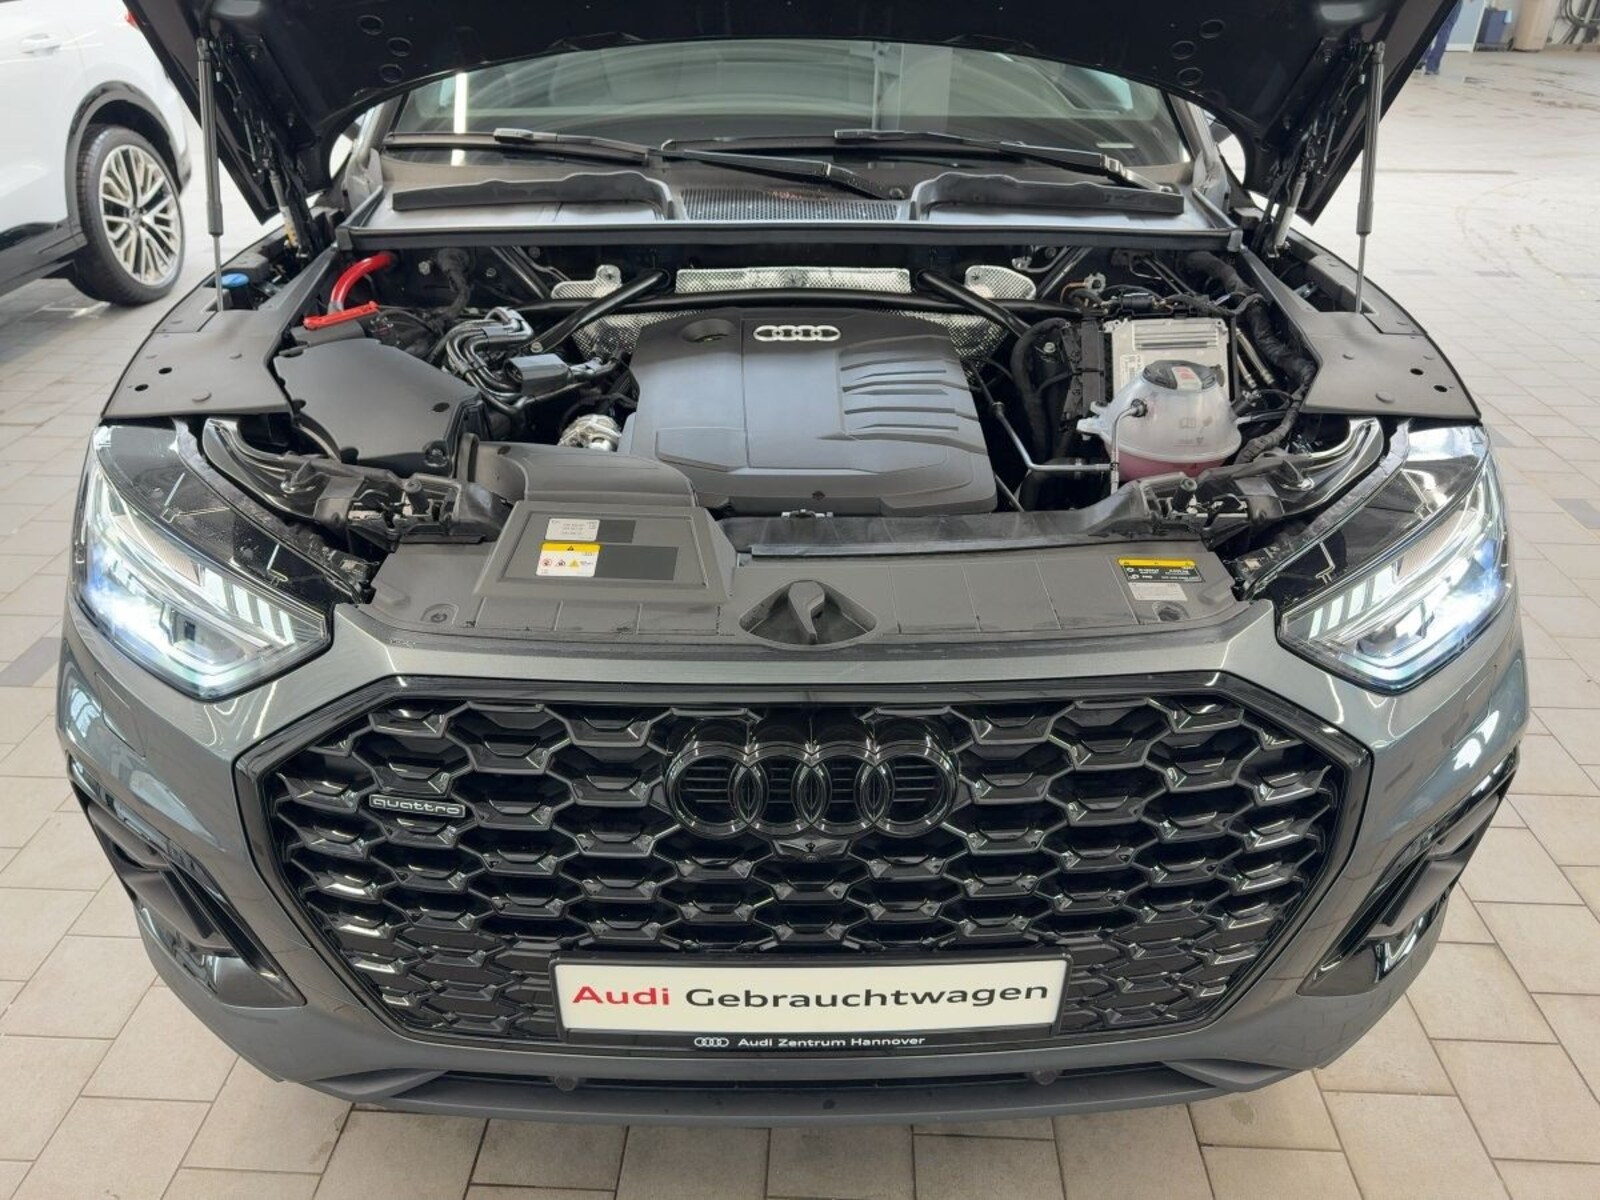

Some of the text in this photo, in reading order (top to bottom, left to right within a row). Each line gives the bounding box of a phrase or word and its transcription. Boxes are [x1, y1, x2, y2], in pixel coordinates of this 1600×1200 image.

[372, 798, 460, 814] quattro
[572, 982, 1049, 1008] Audi Gebrauchtwagen
[738, 1037, 925, 1047] Audi Zentrum Hannover
